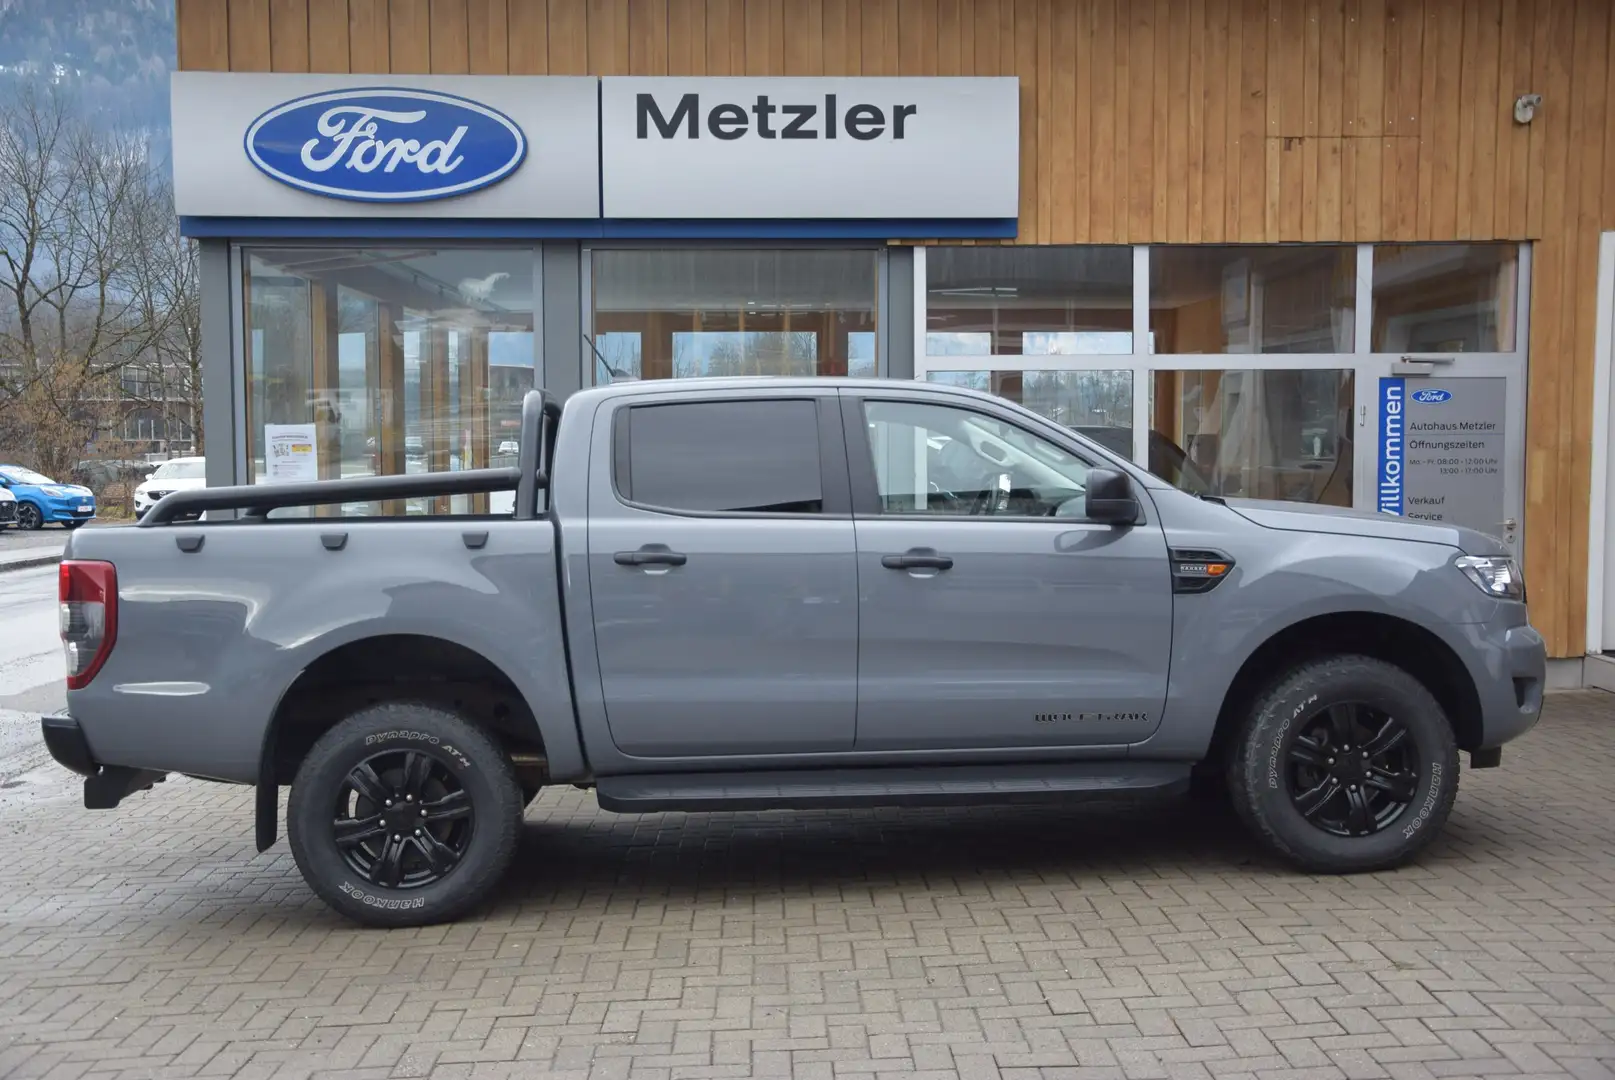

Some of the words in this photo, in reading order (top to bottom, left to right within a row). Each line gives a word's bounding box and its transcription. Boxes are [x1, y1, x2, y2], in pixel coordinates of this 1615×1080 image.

[636, 93, 917, 141] Metzler
[301, 106, 469, 174] Ford
[1418, 390, 1445, 402] Ford
[1409, 422, 1457, 431] Autohaus
[1459, 422, 1496, 431] Metzler
[1409, 440, 1485, 450] Öffnungszeiten
[1408, 496, 1445, 505] Verkauf
[1408, 512, 1443, 521] Service
[366, 730, 440, 746] Dynapro
